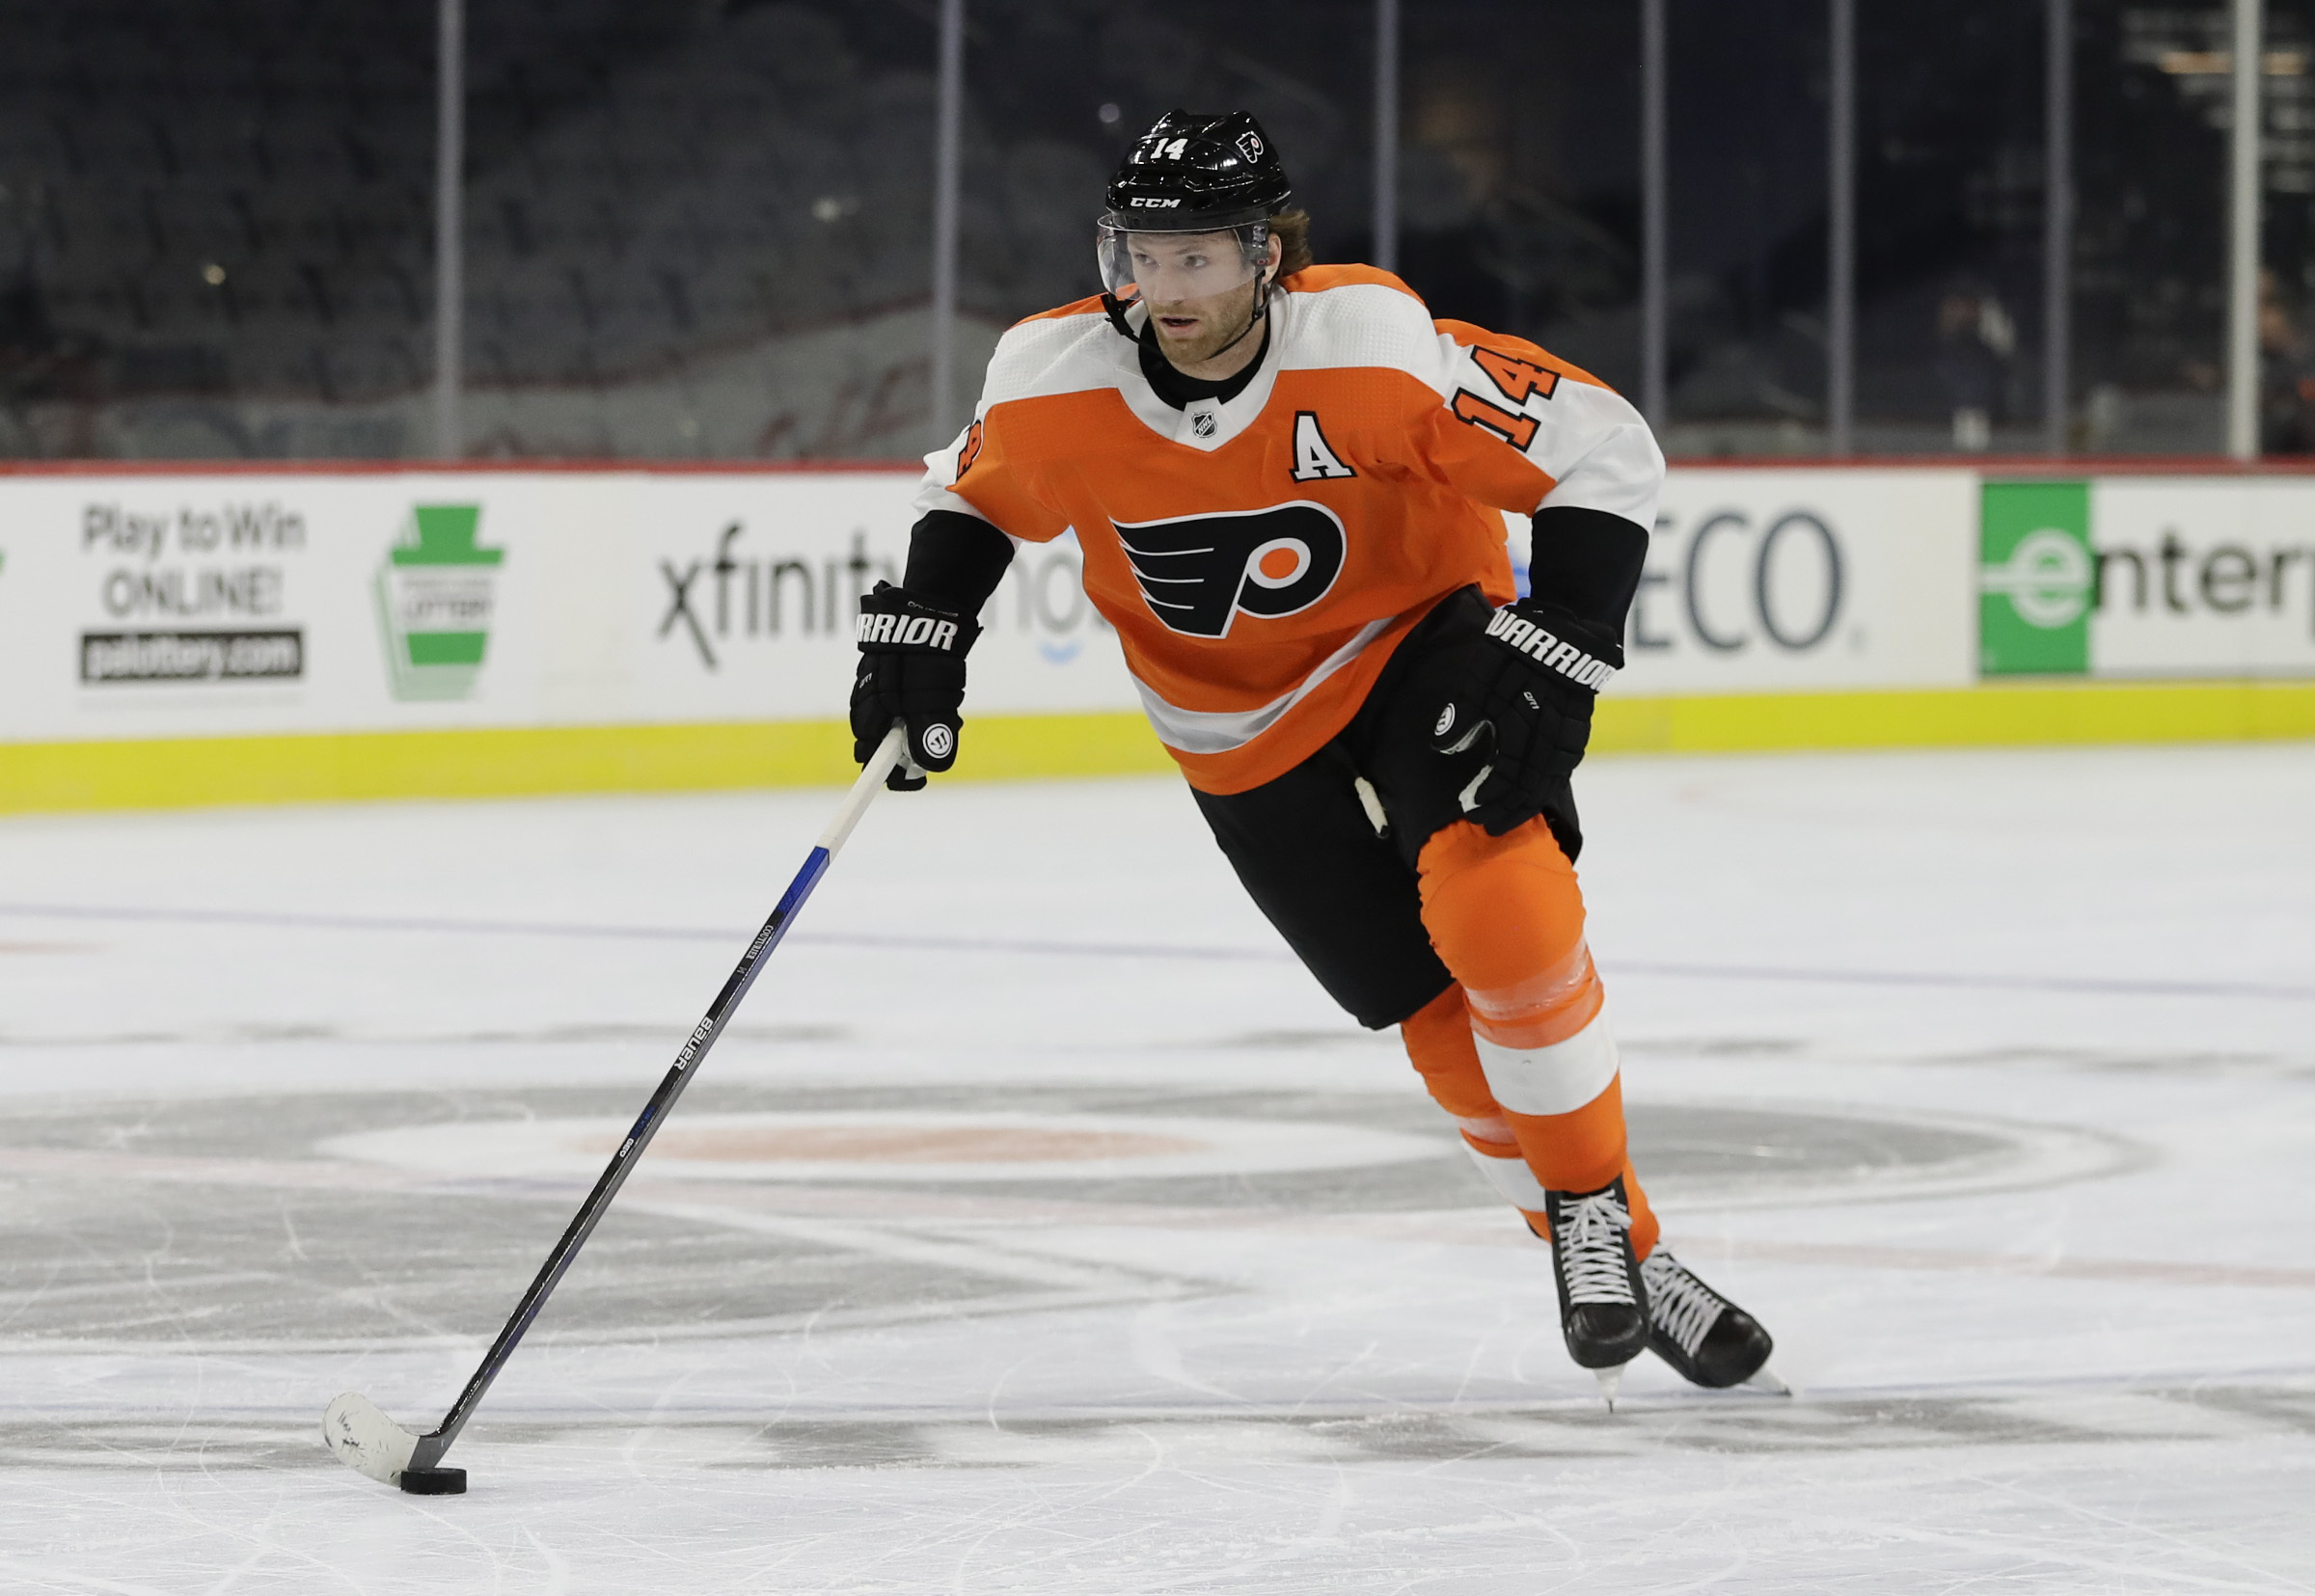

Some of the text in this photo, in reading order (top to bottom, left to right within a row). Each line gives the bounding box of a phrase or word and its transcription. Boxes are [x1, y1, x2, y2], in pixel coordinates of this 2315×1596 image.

[1150, 136, 1188, 161] 14
[1130, 197, 1182, 209] CCM
[1450, 343, 1562, 454] 14
[1289, 410, 1357, 483] A
[82, 501, 306, 561] Play to Win
[1630, 505, 1850, 658] ECO
[1981, 526, 2315, 651] enter
